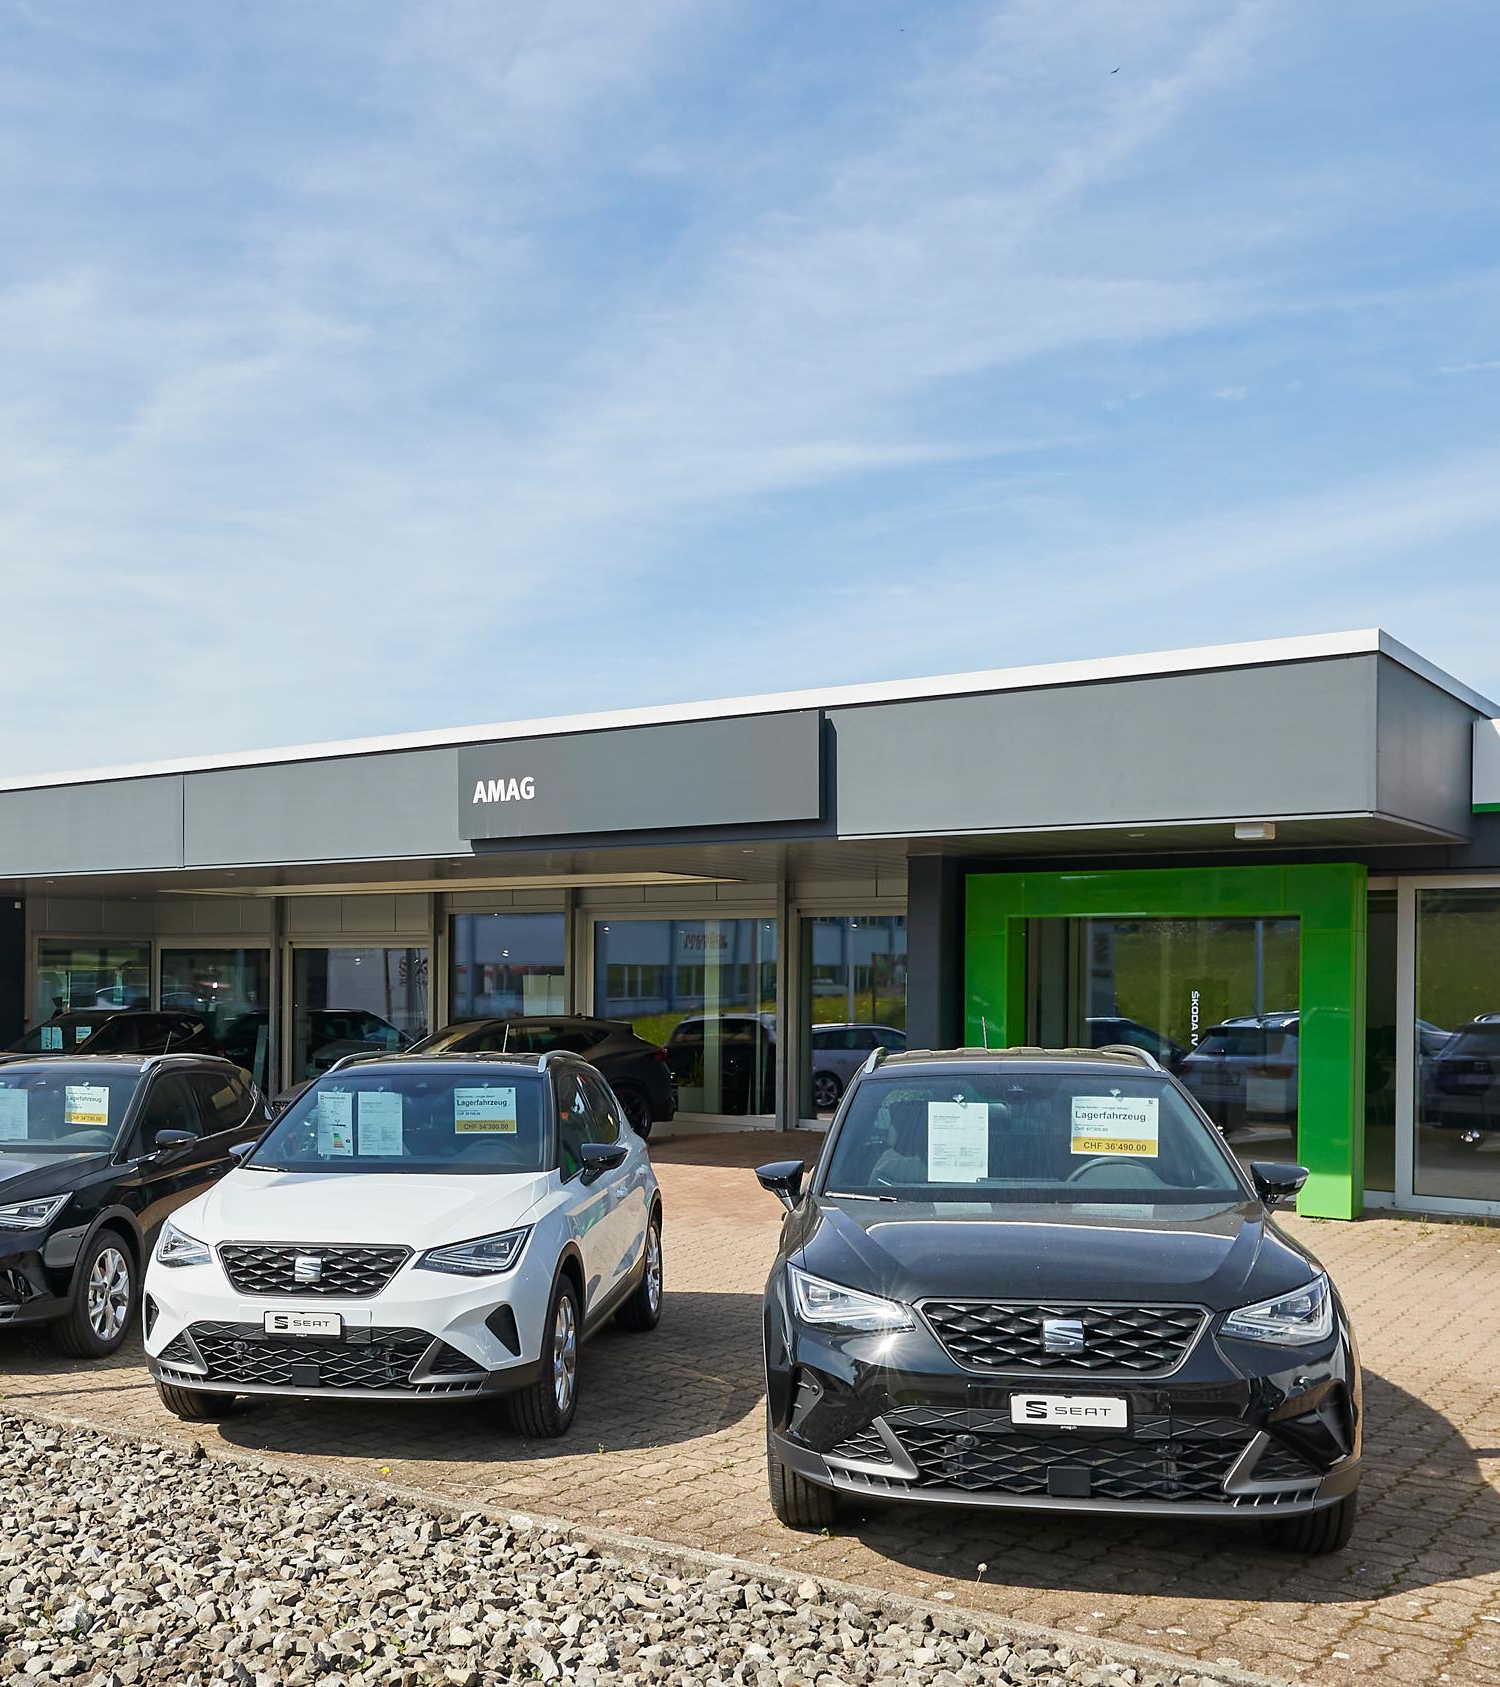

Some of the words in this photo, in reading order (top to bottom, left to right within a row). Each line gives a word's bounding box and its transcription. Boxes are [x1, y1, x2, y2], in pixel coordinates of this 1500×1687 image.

[472, 776, 535, 804] AMAG
[1191, 991, 1200, 1031] ŠKODA
[457, 1099, 508, 1107] Lagerfahrzeug
[1075, 1110, 1146, 1122] Lagerfahrzeug
[1083, 1141, 1103, 1149] CHF
[1105, 1142, 1147, 1151] 36'490.00
[1054, 1406, 1111, 1416] SEAT
